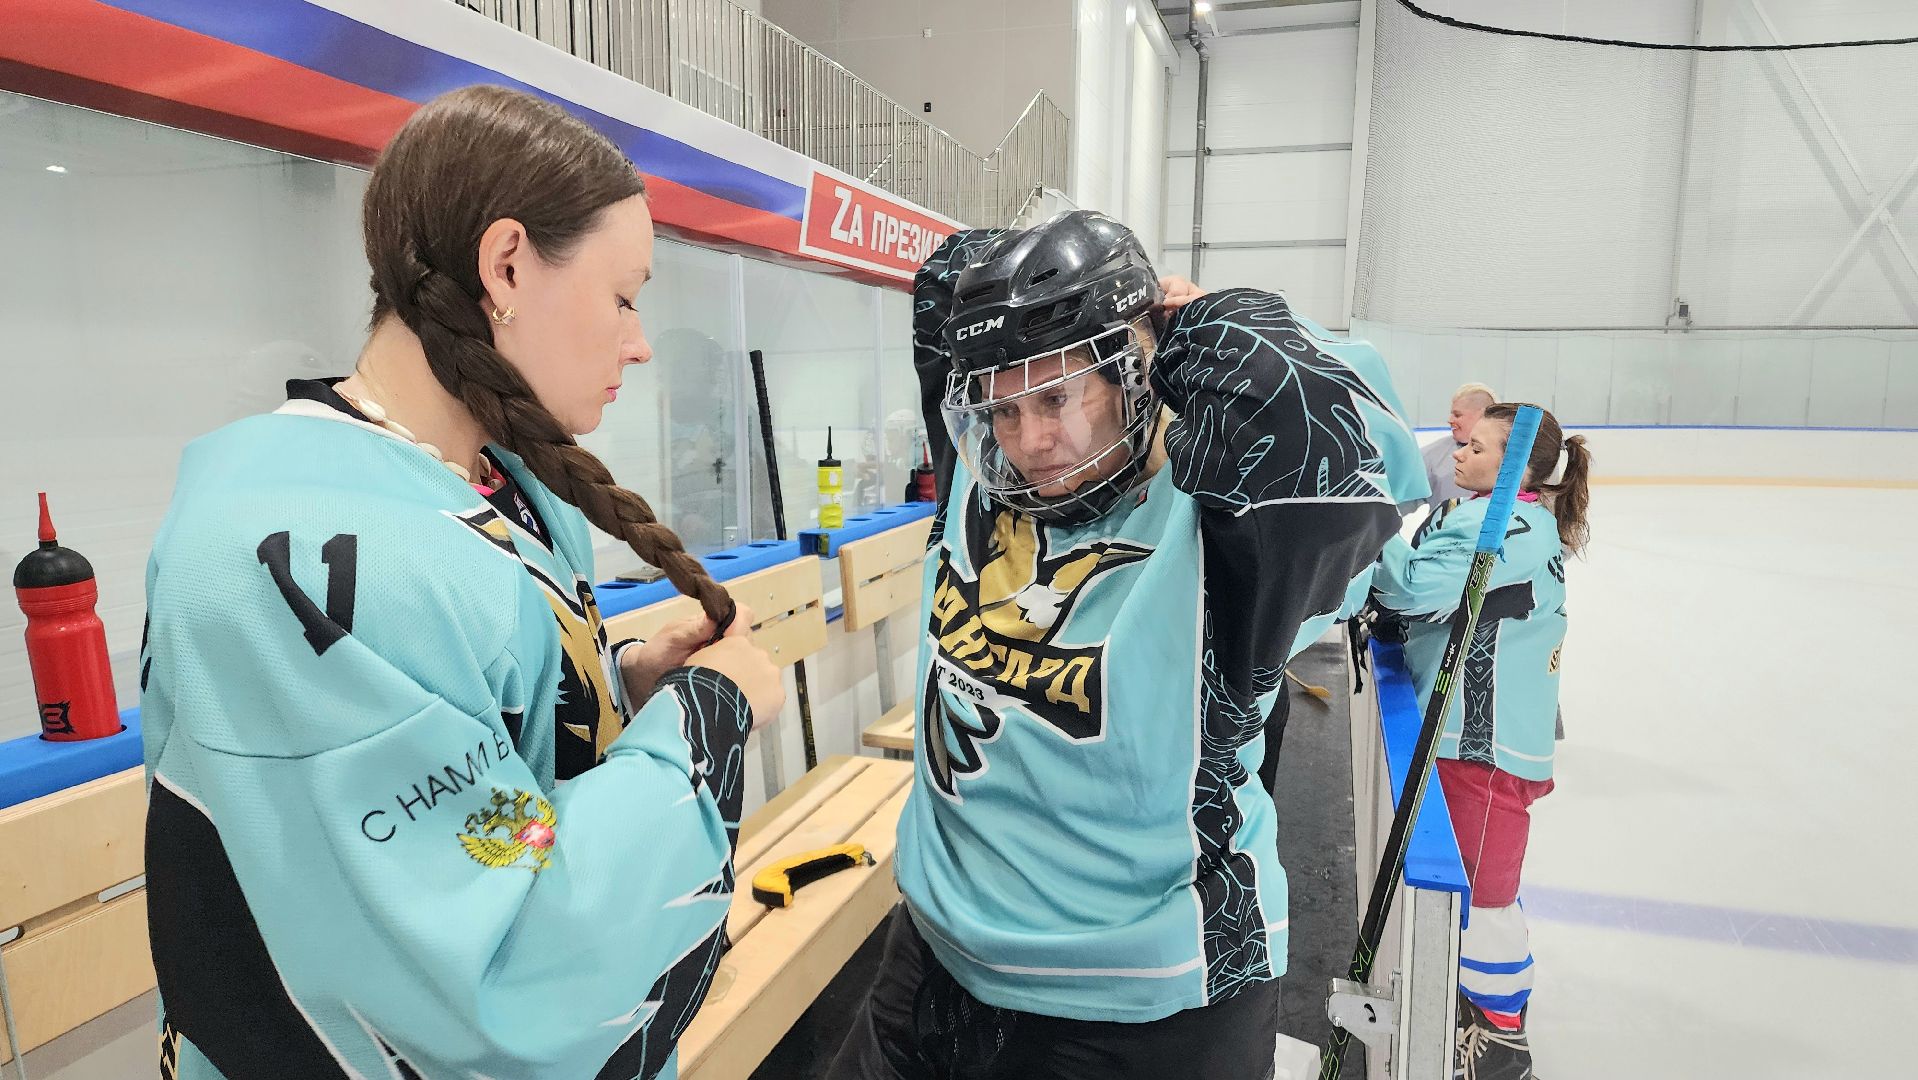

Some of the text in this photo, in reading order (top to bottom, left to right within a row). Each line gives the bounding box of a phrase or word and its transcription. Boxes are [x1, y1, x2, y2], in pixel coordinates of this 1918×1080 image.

[1115, 284, 1147, 313] CCM
[956, 315, 1005, 341] CCM
[948, 672, 985, 701] 2023
